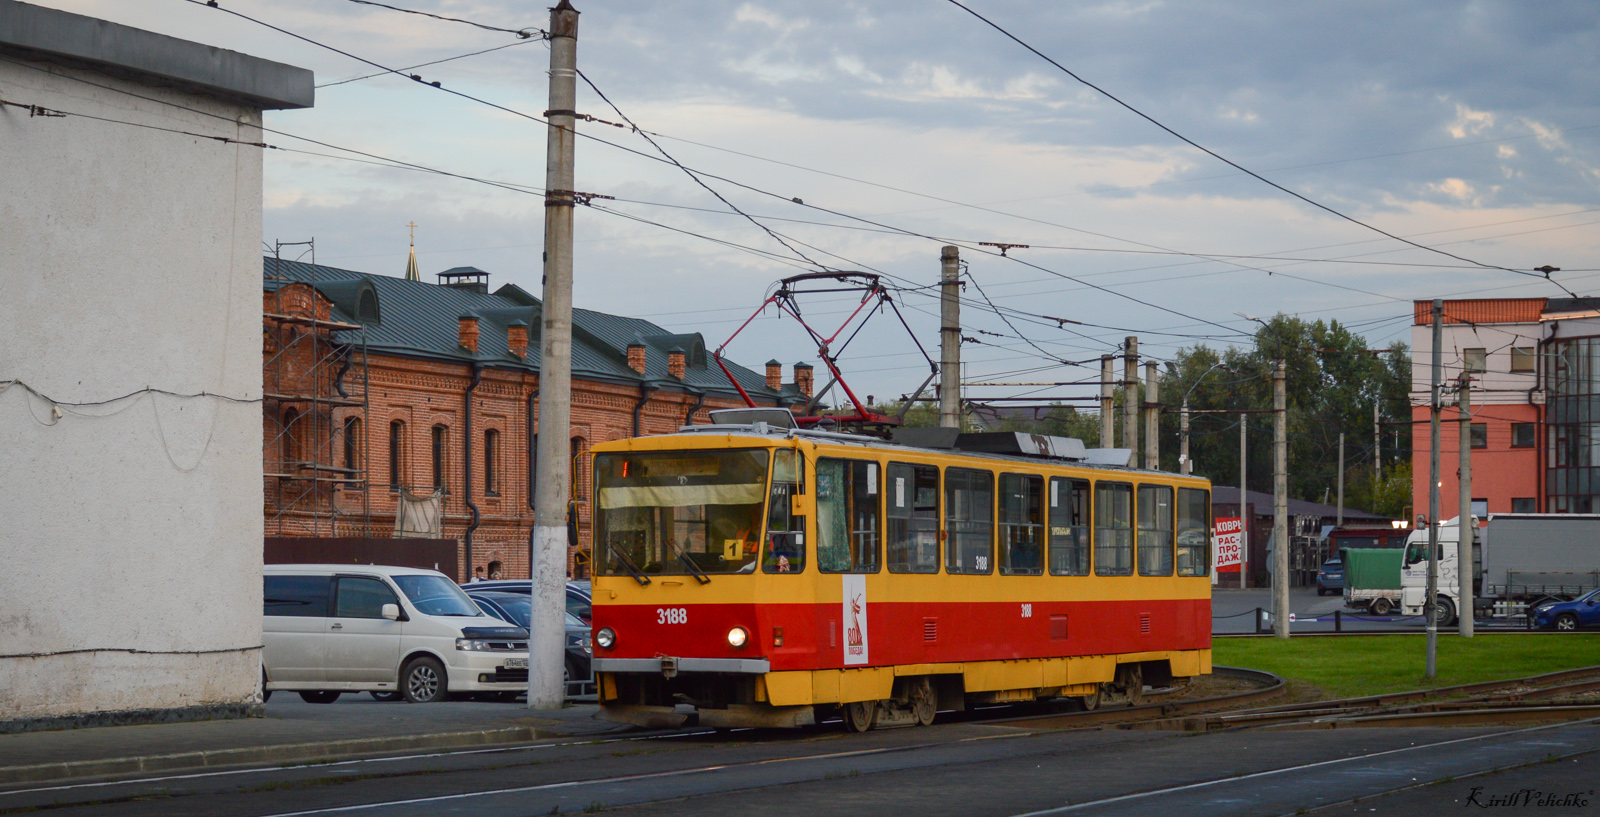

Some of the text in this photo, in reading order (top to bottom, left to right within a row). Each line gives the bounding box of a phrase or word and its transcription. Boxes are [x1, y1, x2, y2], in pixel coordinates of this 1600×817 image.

[728, 543, 737, 557] 1
[1218, 544, 1242, 555] ПРО-
[975, 555, 988, 571] 3188
[1217, 552, 1242, 566] ДАЖ
[656, 608, 688, 624] 3188
[1020, 603, 1032, 618] 3188
[847, 627, 857, 644] 80
